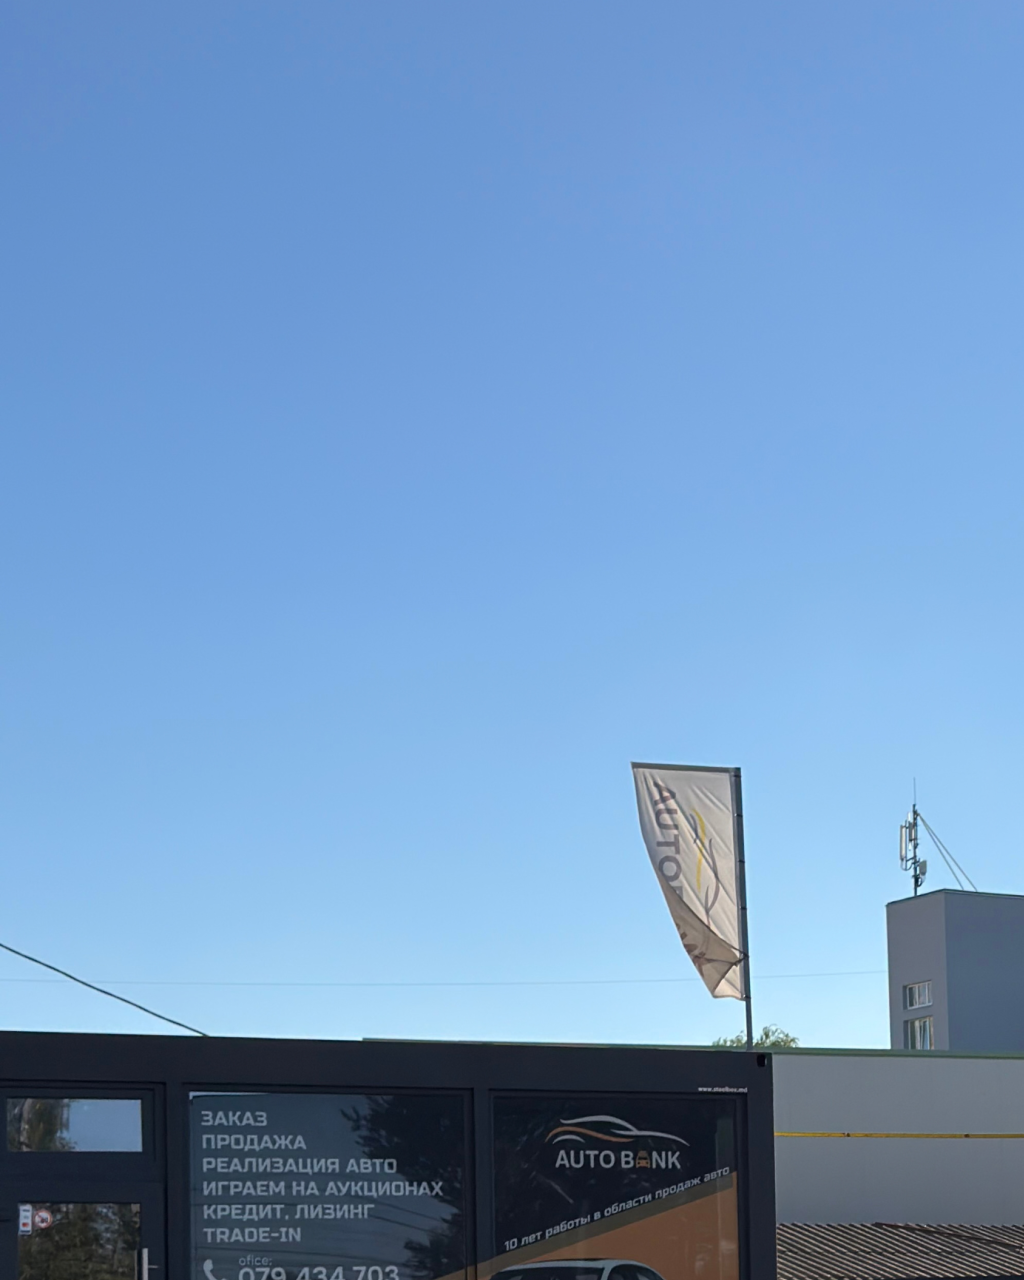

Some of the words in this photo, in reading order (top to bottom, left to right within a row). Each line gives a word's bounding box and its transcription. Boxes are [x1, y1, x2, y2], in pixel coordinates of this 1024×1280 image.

[201, 1111, 267, 1126] ЗАКАЗ
[202, 1134, 306, 1151] ПРОДАЖА
[203, 1157, 339, 1174] РЕАЛИЗАЦИЯ
[346, 1158, 397, 1173] АВТО
[555, 1149, 615, 1169] AUTO
[203, 1181, 285, 1196] ИГРАЕМ
[292, 1181, 319, 1196] НА
[325, 1181, 443, 1198] АУКЦИОНАХ
[203, 1204, 289, 1221] КРЕДИТ,
[295, 1204, 375, 1219] ЛИЗИНГ
[504, 1238, 518, 1251] 10
[520, 1230, 543, 1246] лет
[545, 1214, 591, 1237] работы
[594, 1211, 601, 1220] в
[604, 1193, 652, 1217] области
[655, 1174, 702, 1199] продаж
[703, 1166, 730, 1182] авто
[203, 1227, 302, 1243] TRADE-IN
